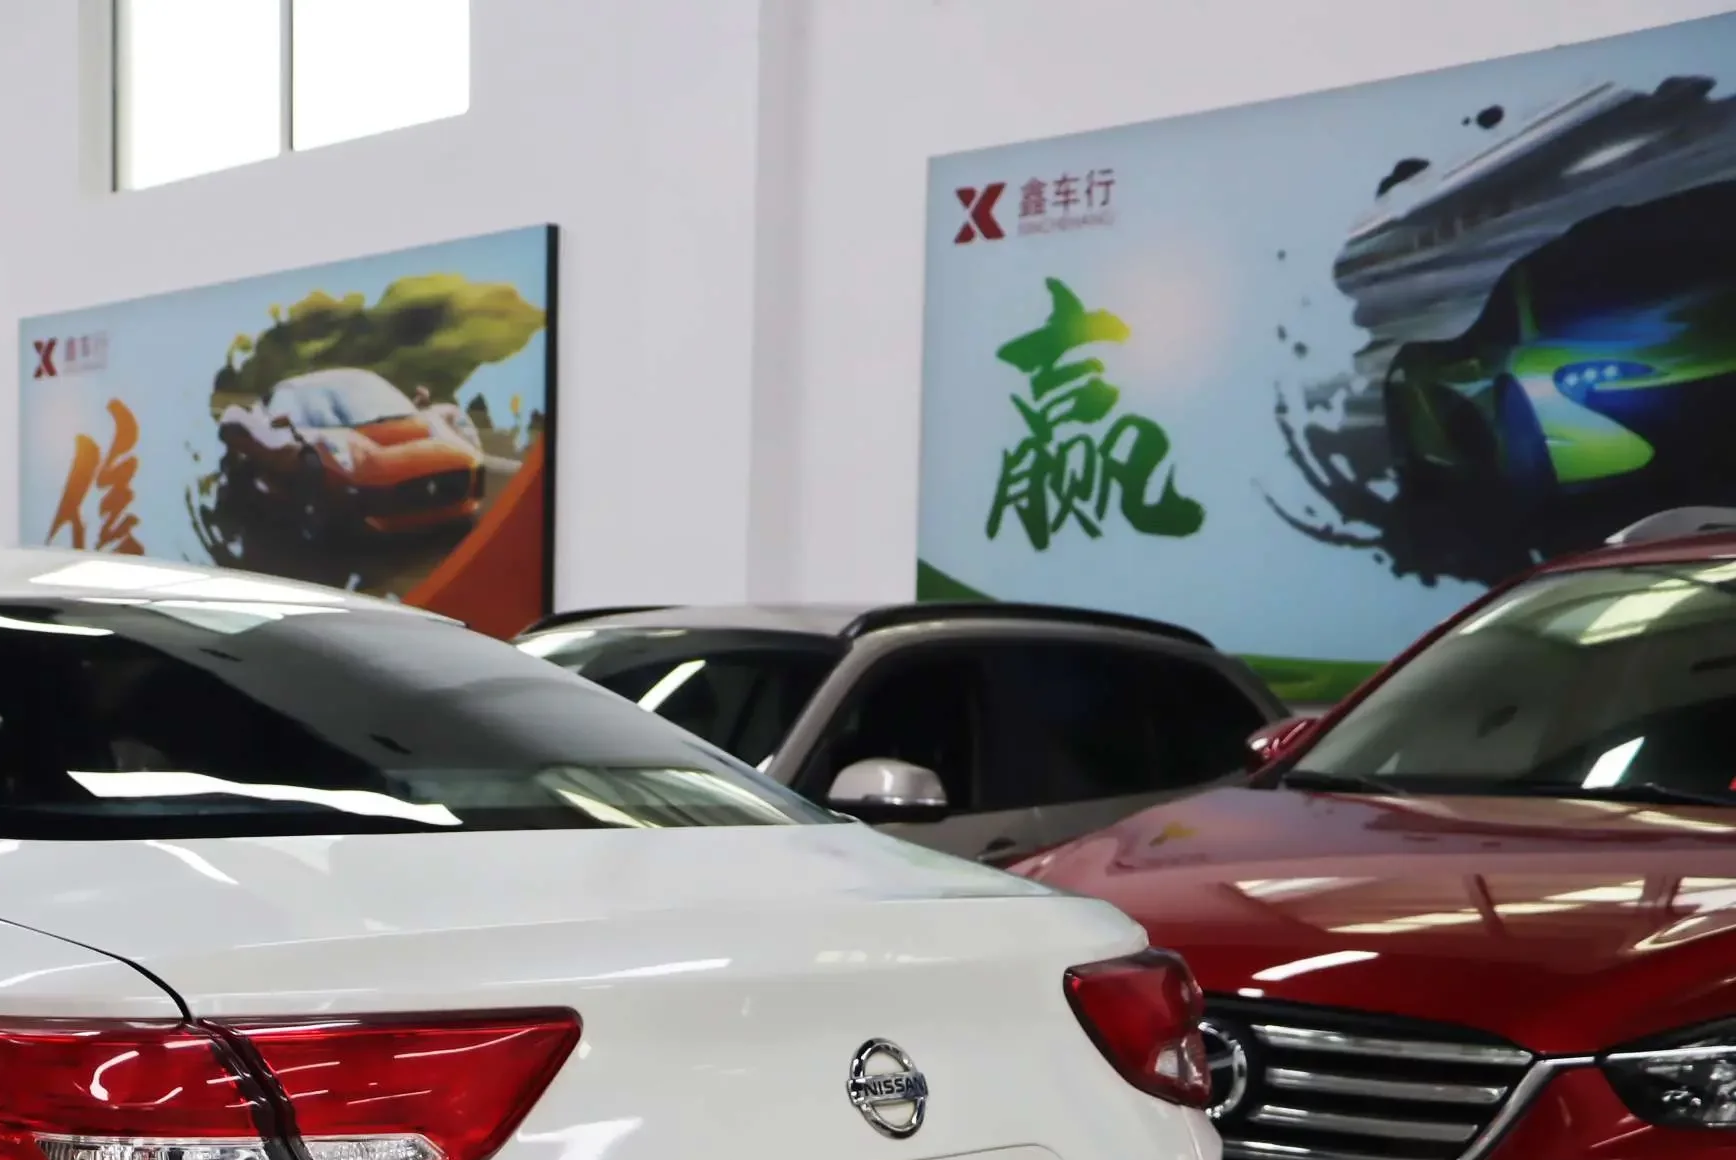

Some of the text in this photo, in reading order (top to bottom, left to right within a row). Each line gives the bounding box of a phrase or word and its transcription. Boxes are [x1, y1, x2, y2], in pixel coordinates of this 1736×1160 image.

[1018, 167, 1116, 218] 鑫车行
[986, 276, 1206, 552] 赢
[46, 398, 145, 556] 信
[864, 1075, 926, 1097] NISSAN
